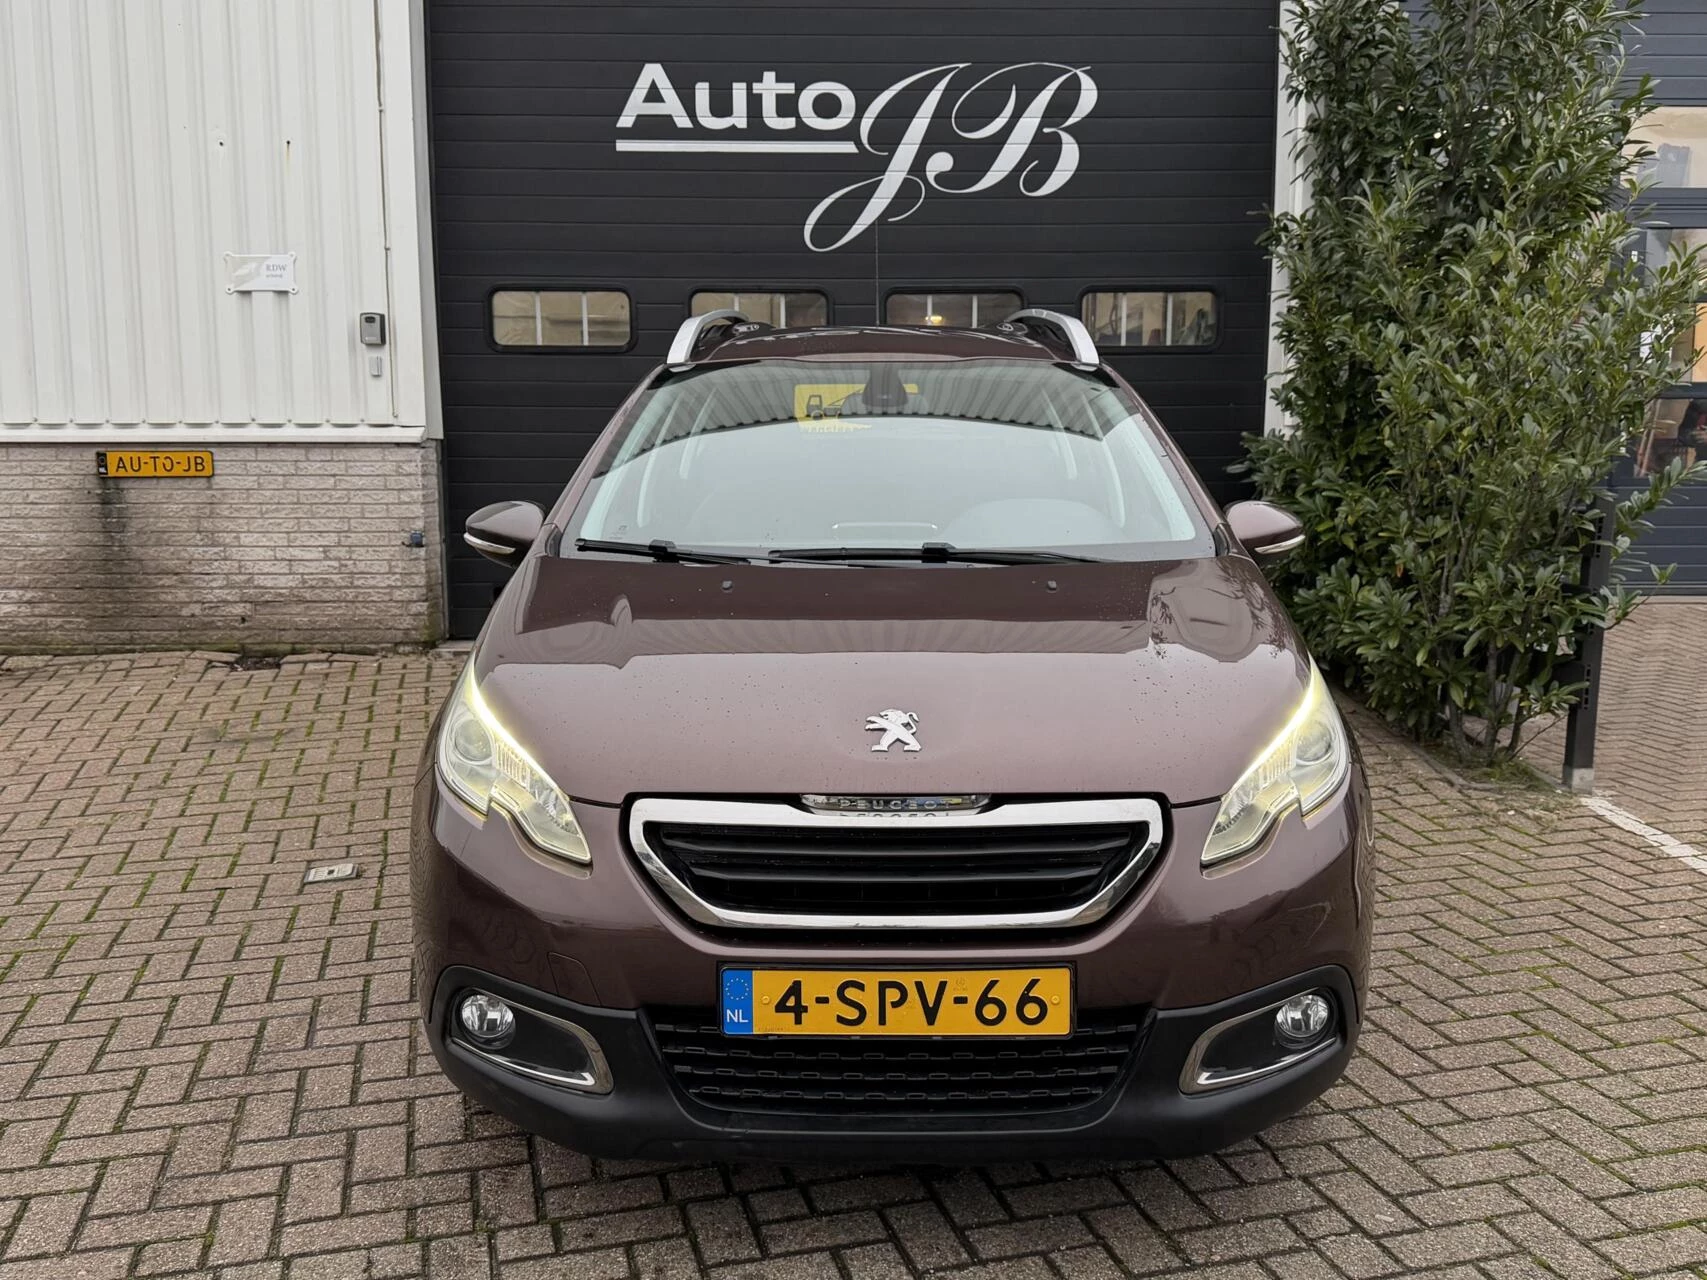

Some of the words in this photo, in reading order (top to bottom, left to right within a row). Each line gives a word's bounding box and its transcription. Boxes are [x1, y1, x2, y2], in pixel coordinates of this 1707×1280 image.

[615, 63, 856, 131] Auto
[803, 61, 1099, 252] JB
[265, 264, 288, 272] RDW
[115, 456, 206, 473] AU-TO-JB
[774, 978, 1049, 1027] 4-SPV-66
[726, 1009, 749, 1024] NL
